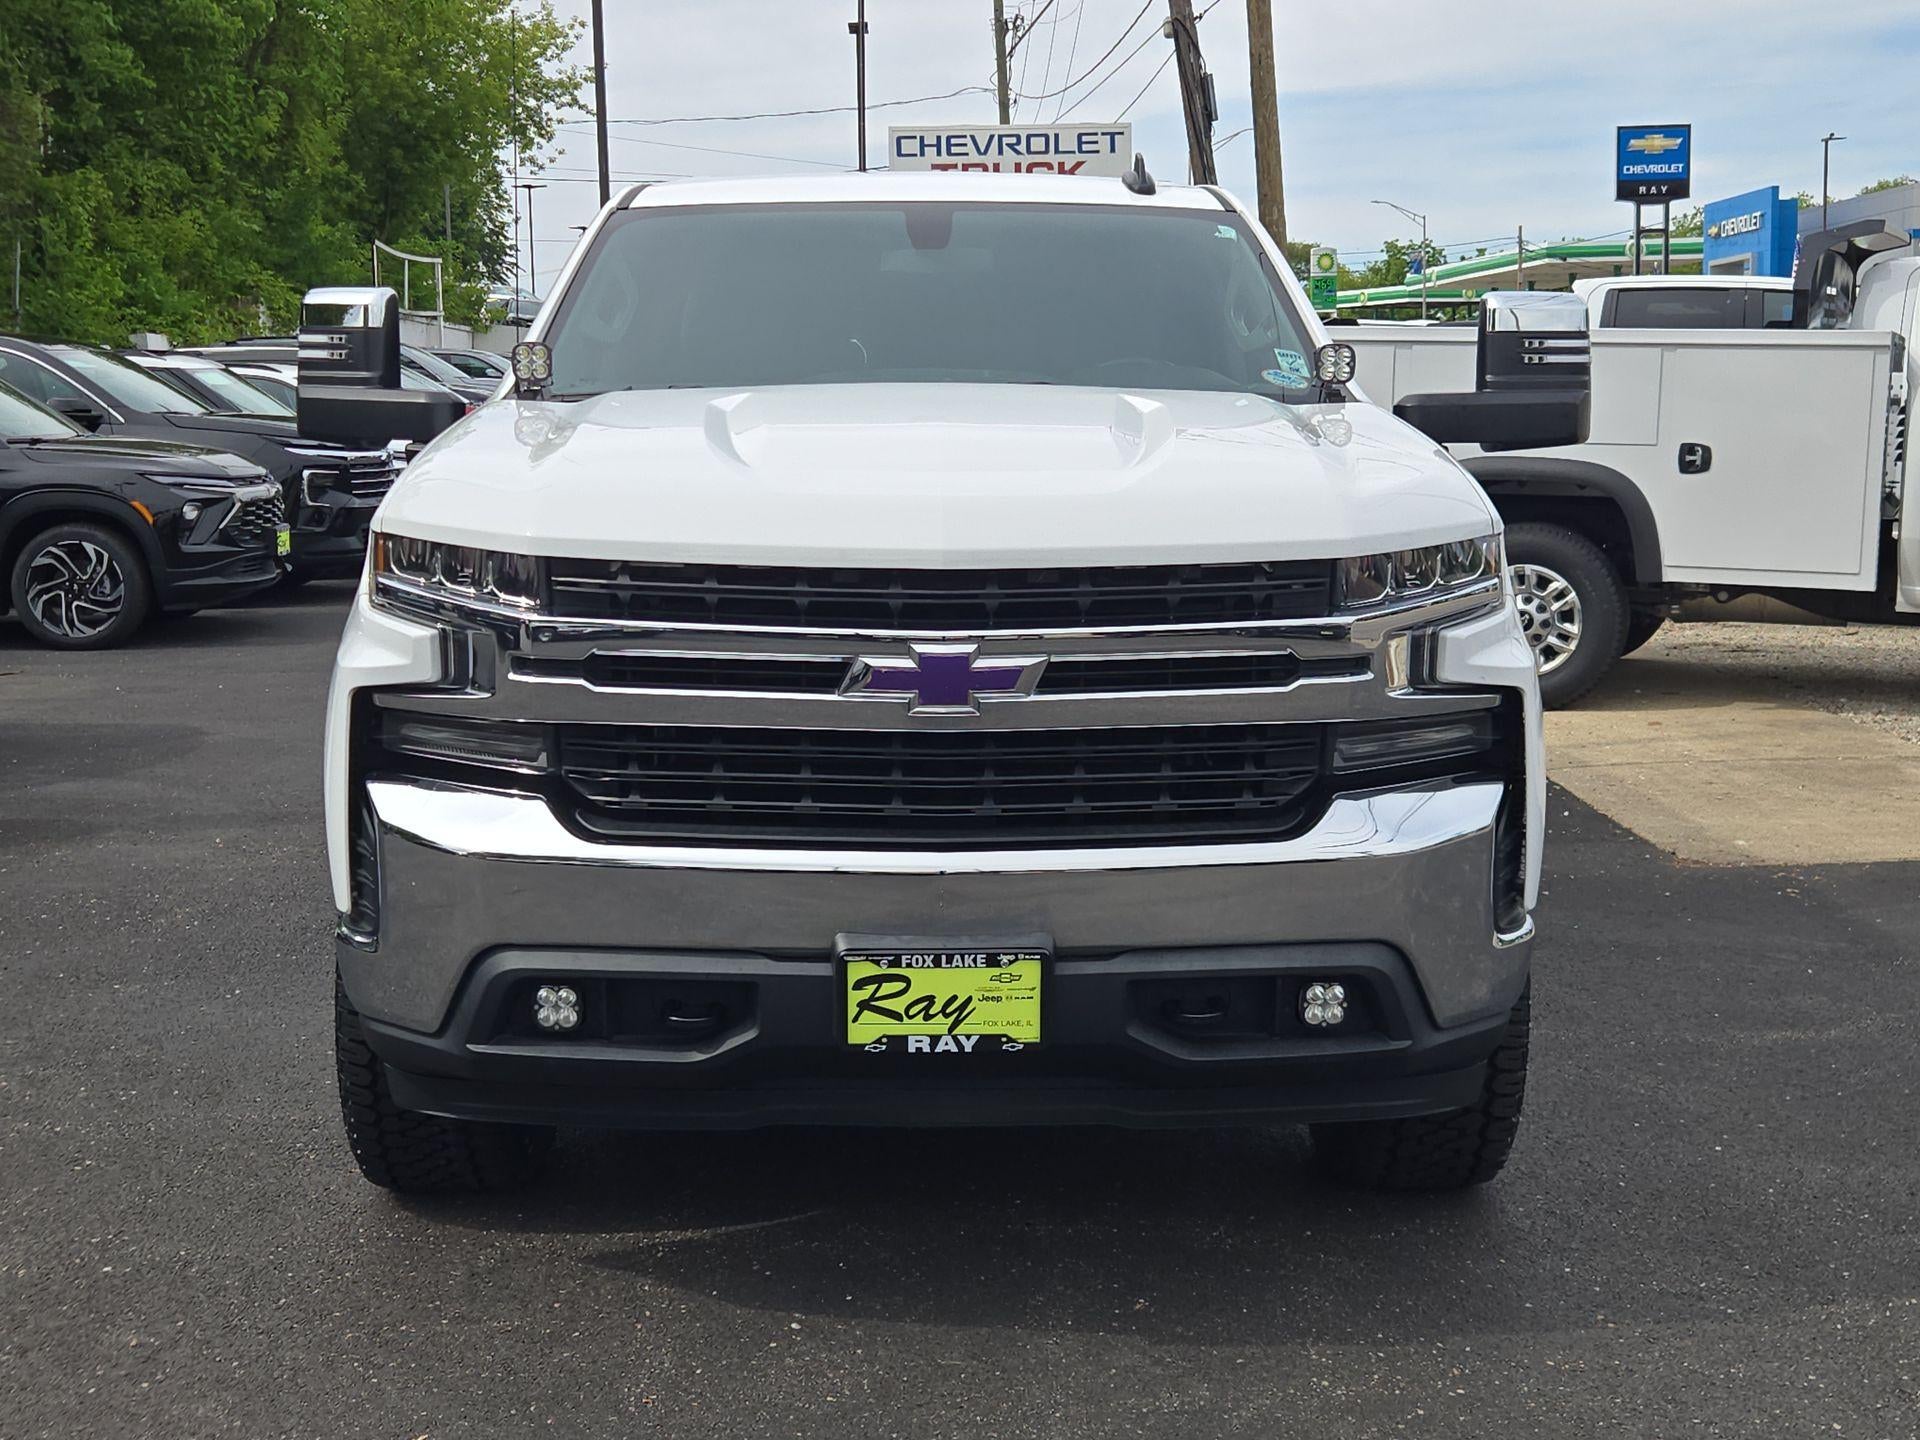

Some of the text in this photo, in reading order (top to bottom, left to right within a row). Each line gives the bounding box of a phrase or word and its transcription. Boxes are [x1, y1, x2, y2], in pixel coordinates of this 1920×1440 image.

[895, 131, 1125, 158] CHEVROLET
[1623, 163, 1684, 174] CHEVROLET
[1638, 185, 1668, 195] RAY
[1720, 210, 1761, 237] CHEVROLET
[901, 954, 987, 968] FOX LAKE
[851, 973, 977, 1035] Ray
[977, 994, 1003, 1003] Jeep
[907, 1034, 980, 1053] RAY
